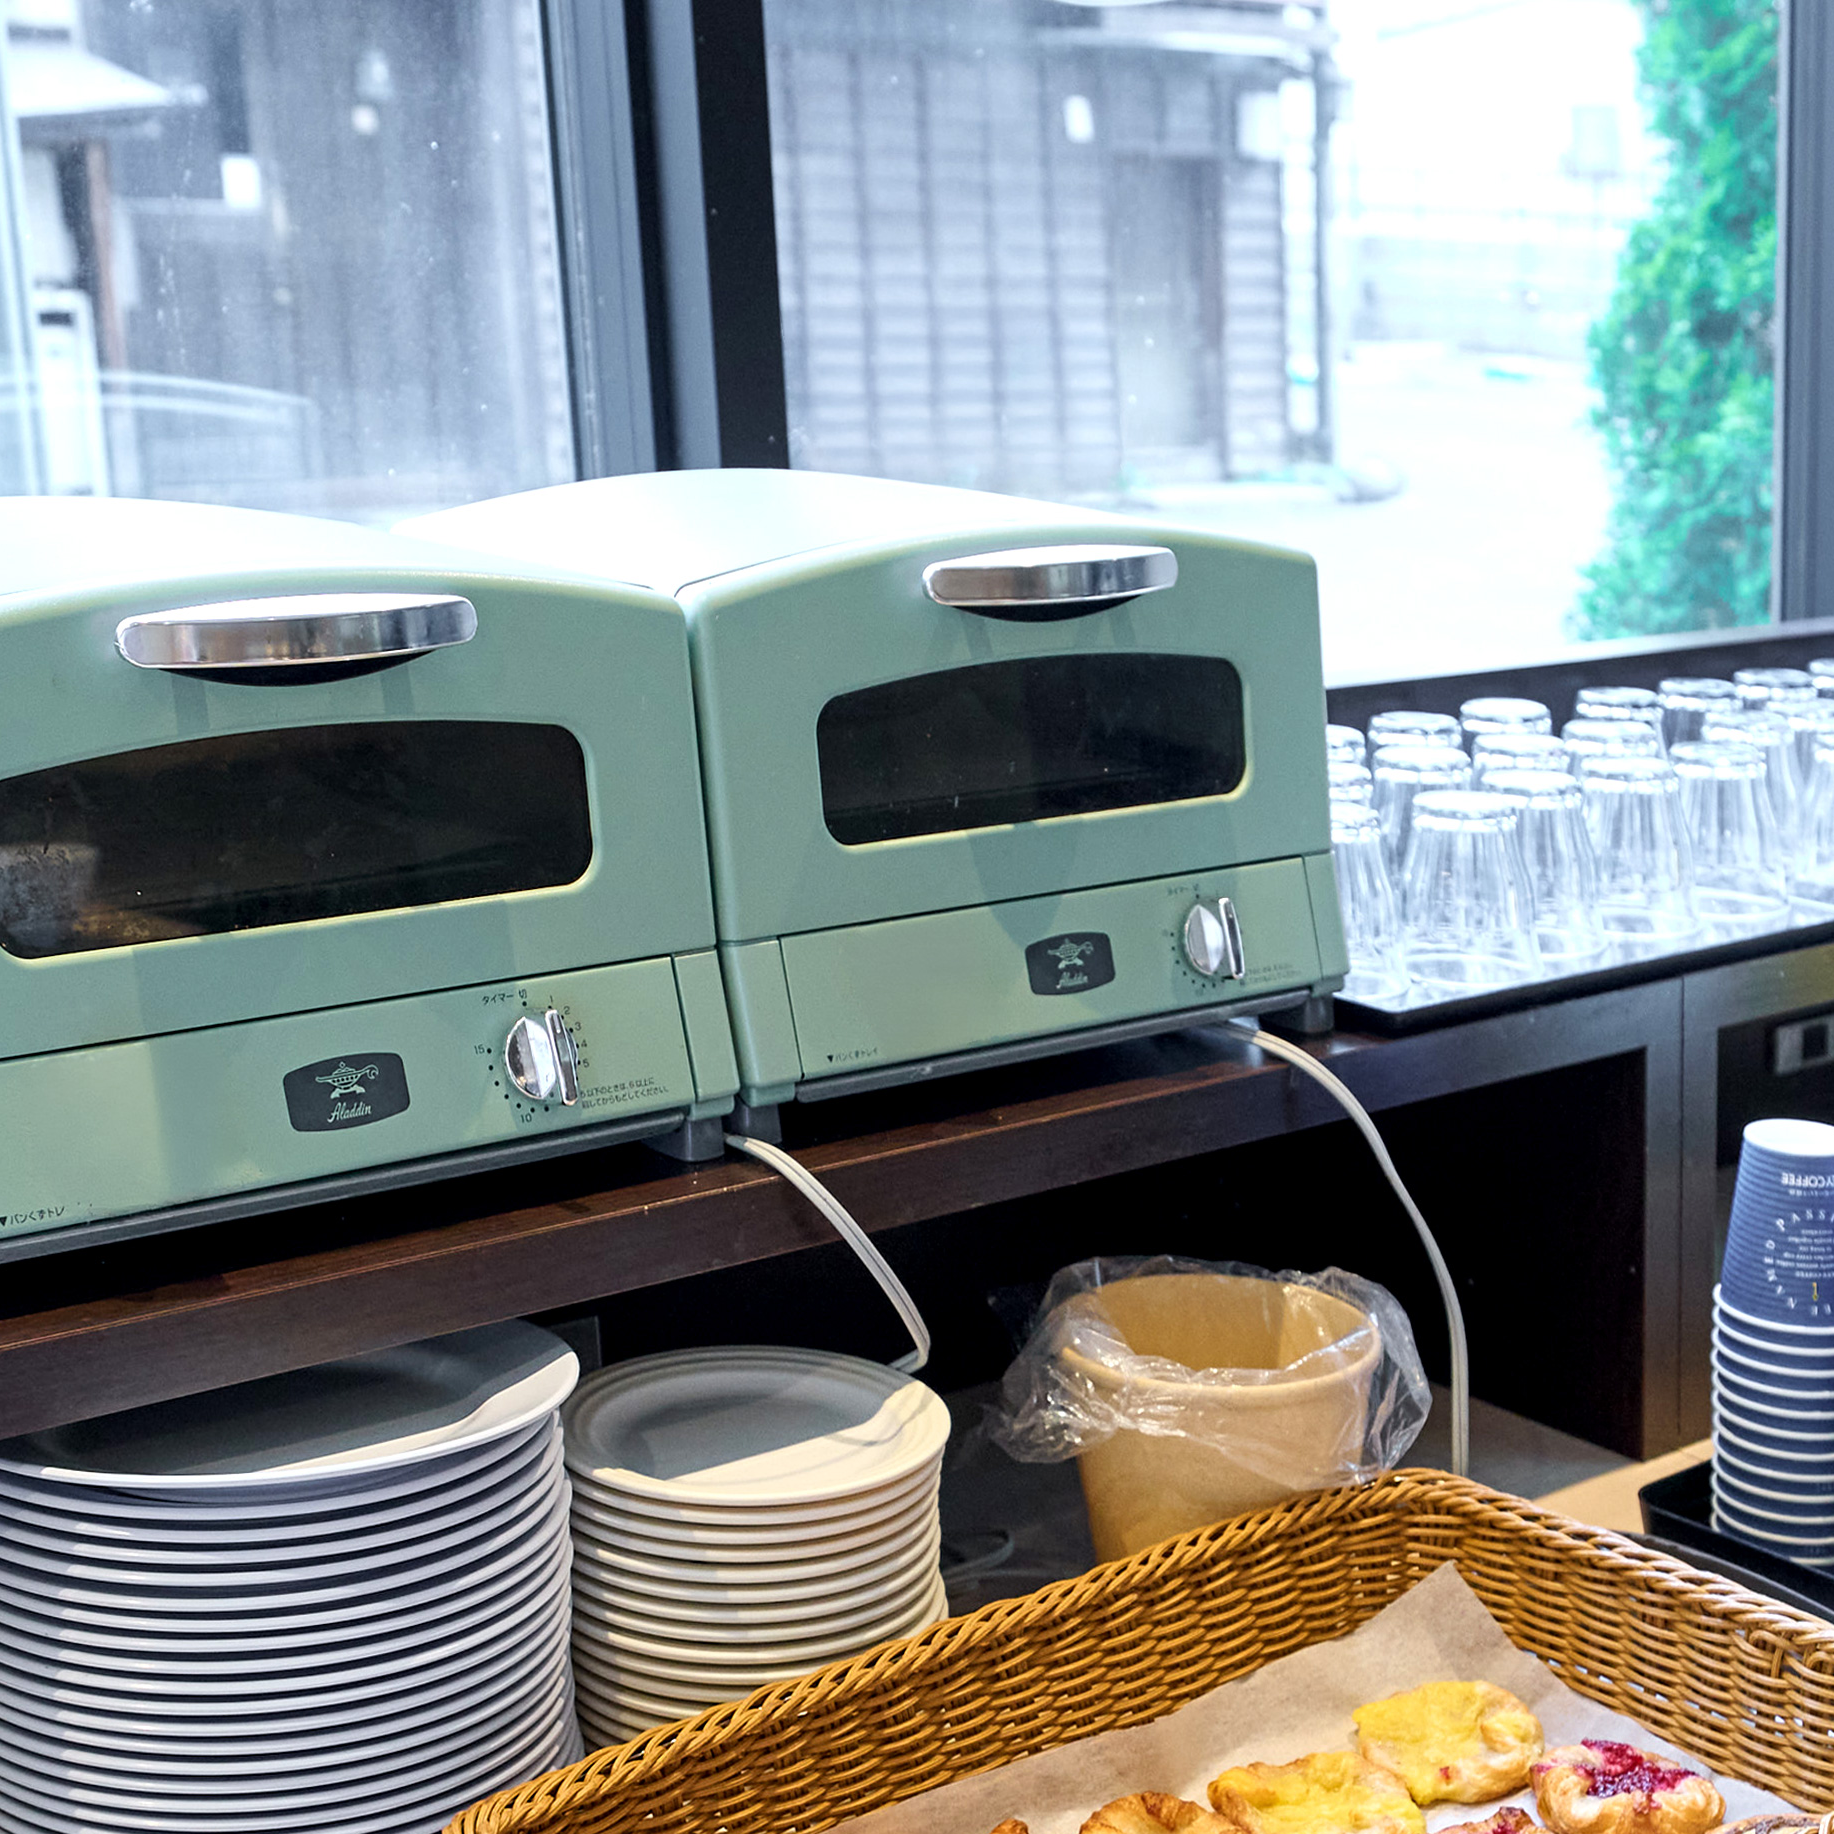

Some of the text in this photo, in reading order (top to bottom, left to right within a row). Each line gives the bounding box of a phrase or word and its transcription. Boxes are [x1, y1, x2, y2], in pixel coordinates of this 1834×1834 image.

[482, 993, 515, 1006] タイマー
[564, 1006, 570, 1015] 2
[574, 1022, 582, 1032] 3
[580, 1039, 588, 1048] 4
[474, 1045, 486, 1055] 15
[583, 1060, 590, 1069] 5
[327, 1101, 372, 1123] Aladdin
[521, 1113, 533, 1124] 10
